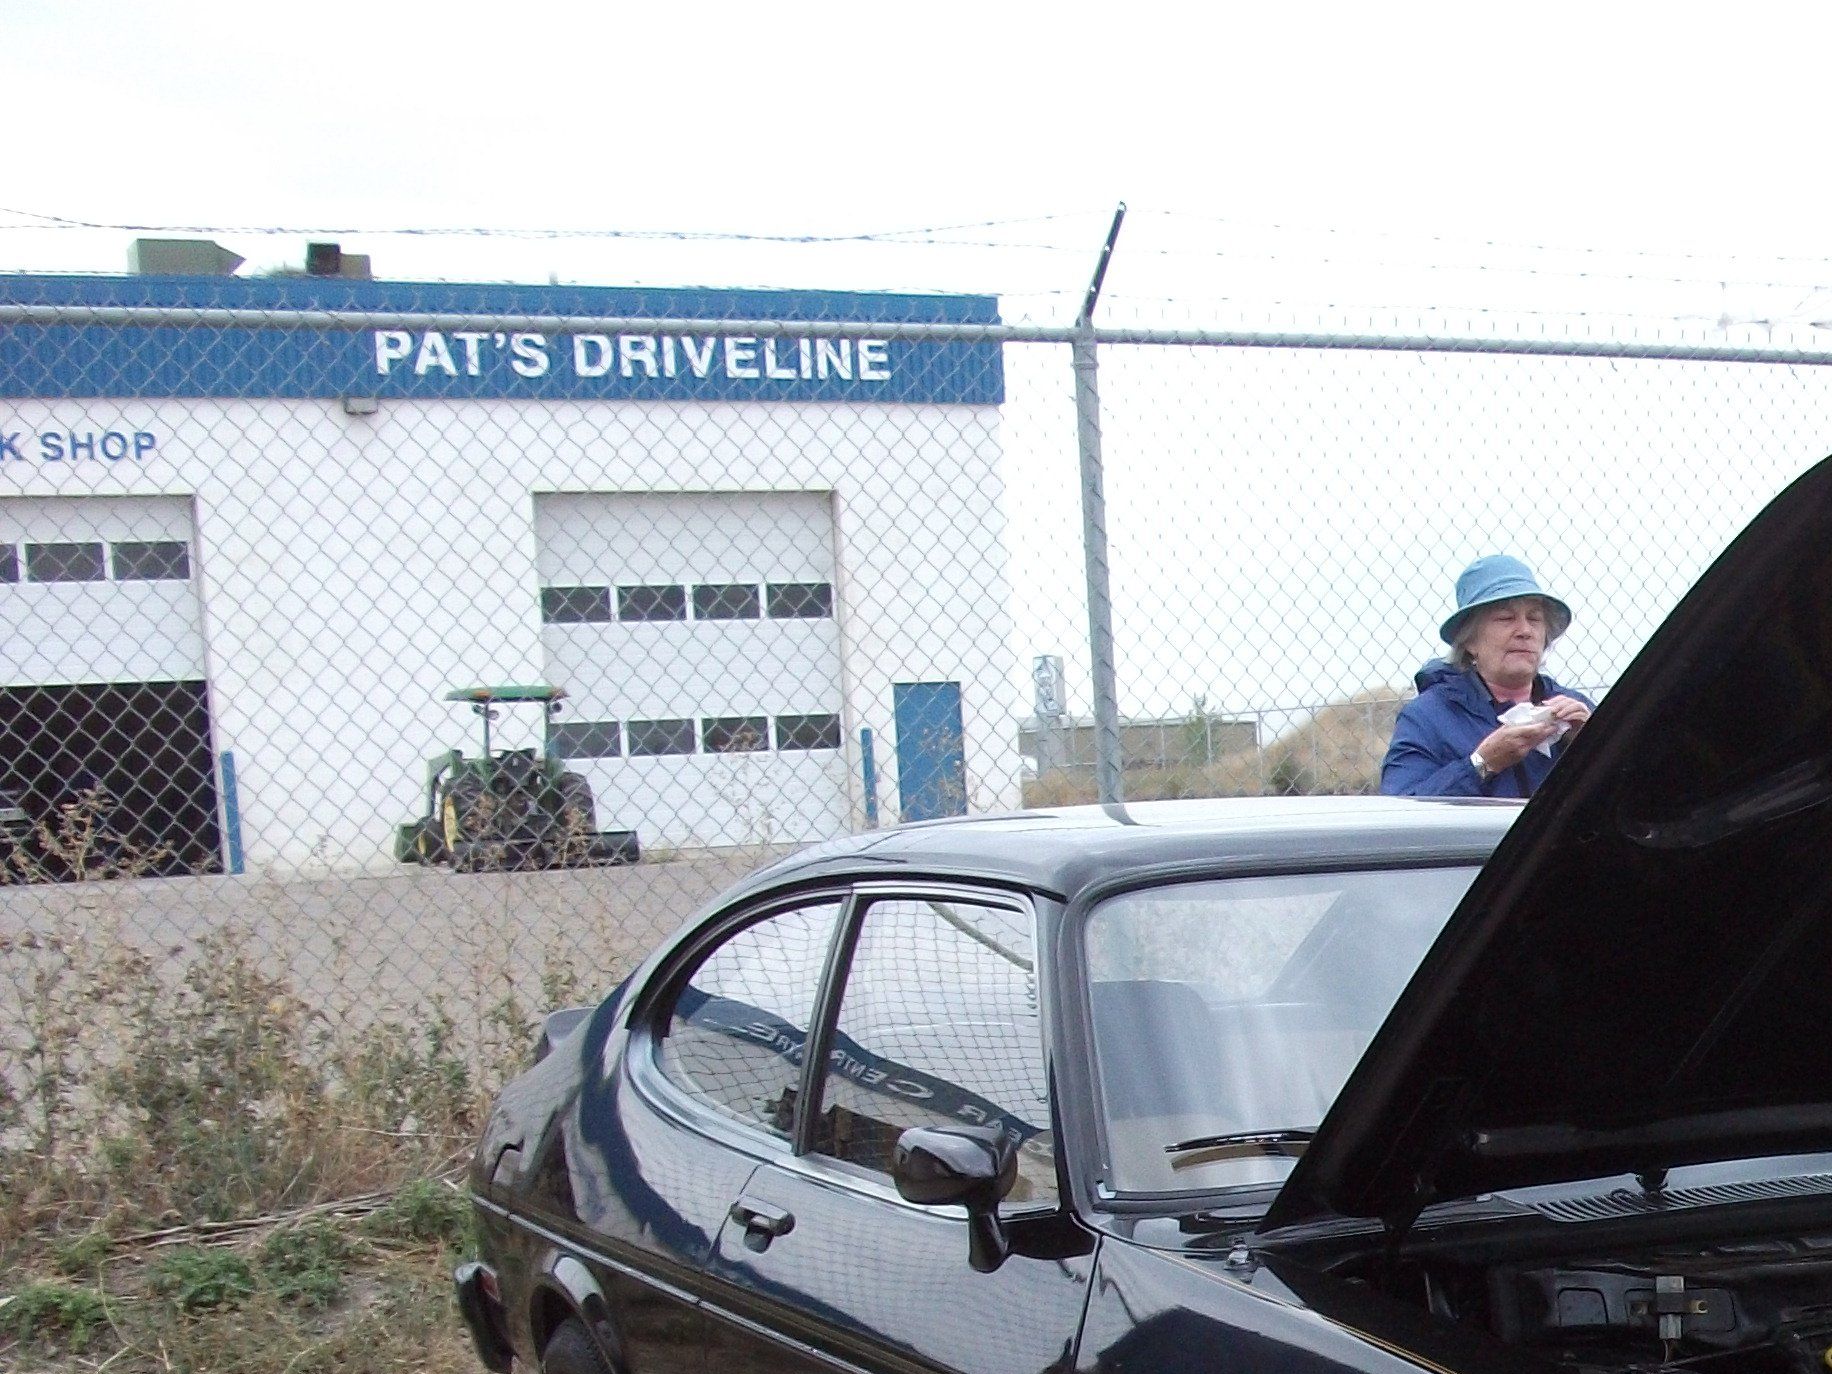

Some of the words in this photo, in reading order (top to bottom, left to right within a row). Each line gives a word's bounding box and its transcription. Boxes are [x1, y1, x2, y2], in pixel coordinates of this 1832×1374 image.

[374, 330, 550, 378] PAT'S
[572, 334, 892, 381] DRIVELINE
[40, 431, 156, 462] SHOP
